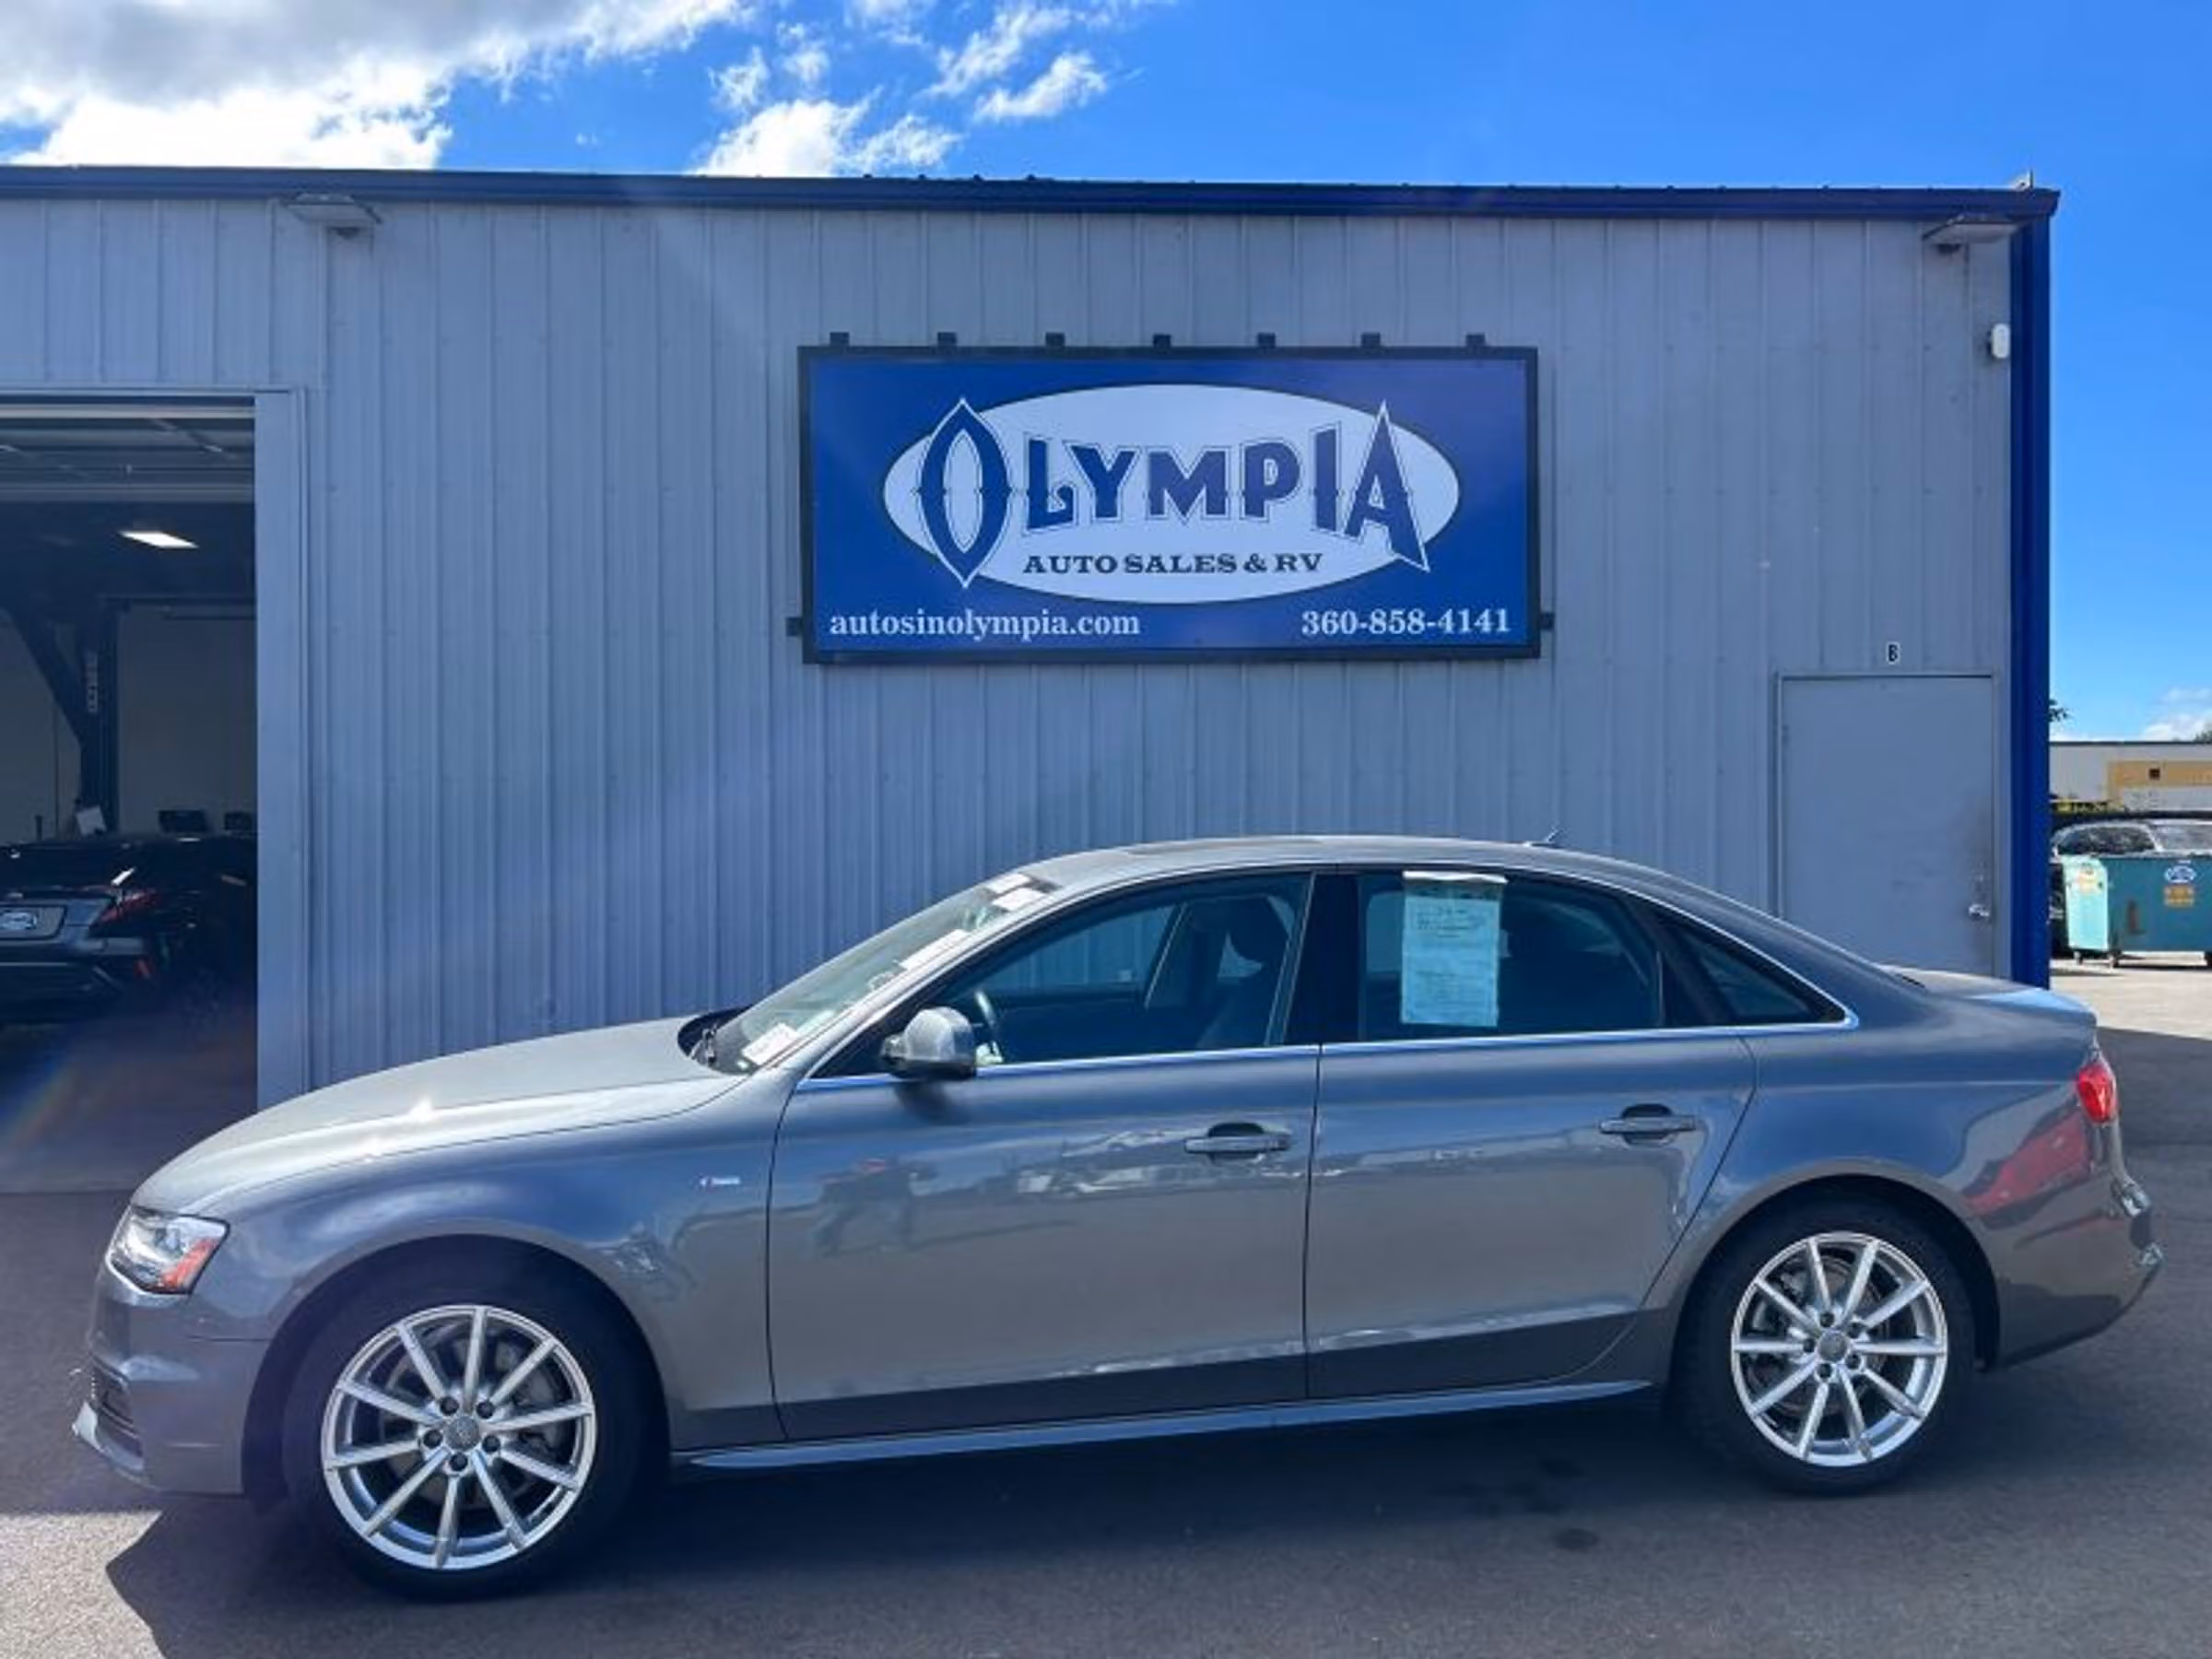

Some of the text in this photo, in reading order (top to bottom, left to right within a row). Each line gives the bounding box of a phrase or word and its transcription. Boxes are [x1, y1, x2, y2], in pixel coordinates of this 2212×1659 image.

[914, 398, 1430, 588] OLYMPIA
[1022, 552, 1324, 574] AUTO SALES & RV
[830, 608, 1141, 642] autosinolympia.com
[1300, 607, 1512, 636] 360-858-4141
[1888, 643, 1899, 663] B
